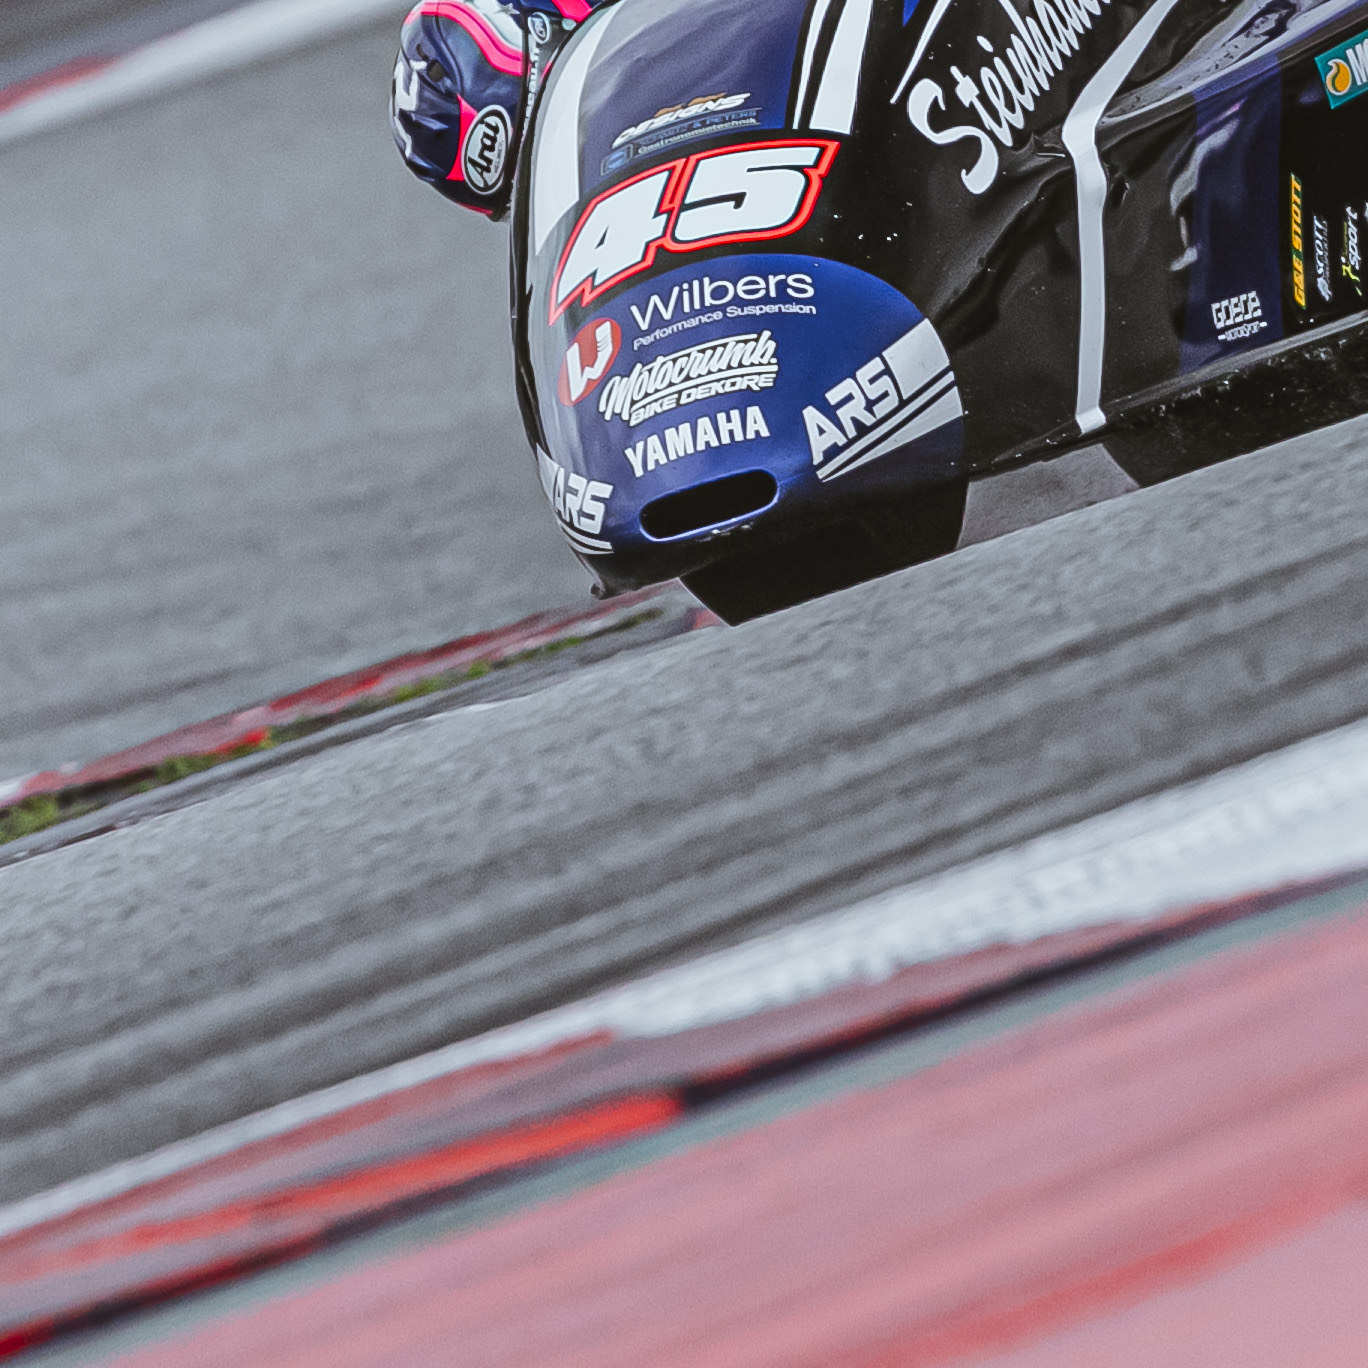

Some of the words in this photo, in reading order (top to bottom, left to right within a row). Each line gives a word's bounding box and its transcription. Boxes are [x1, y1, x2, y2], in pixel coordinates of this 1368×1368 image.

[468, 120, 500, 188] Arai
[554, 142, 832, 316] 45
[630, 274, 815, 331] Wilbers
[634, 310, 723, 351] Performance
[726, 301, 817, 319] Suspension
[629, 395, 678, 427] BIKE
[679, 373, 777, 405] DEKORE
[802, 356, 900, 466] ARS
[624, 405, 771, 478] YAMAHA
[553, 467, 614, 535] ARS
